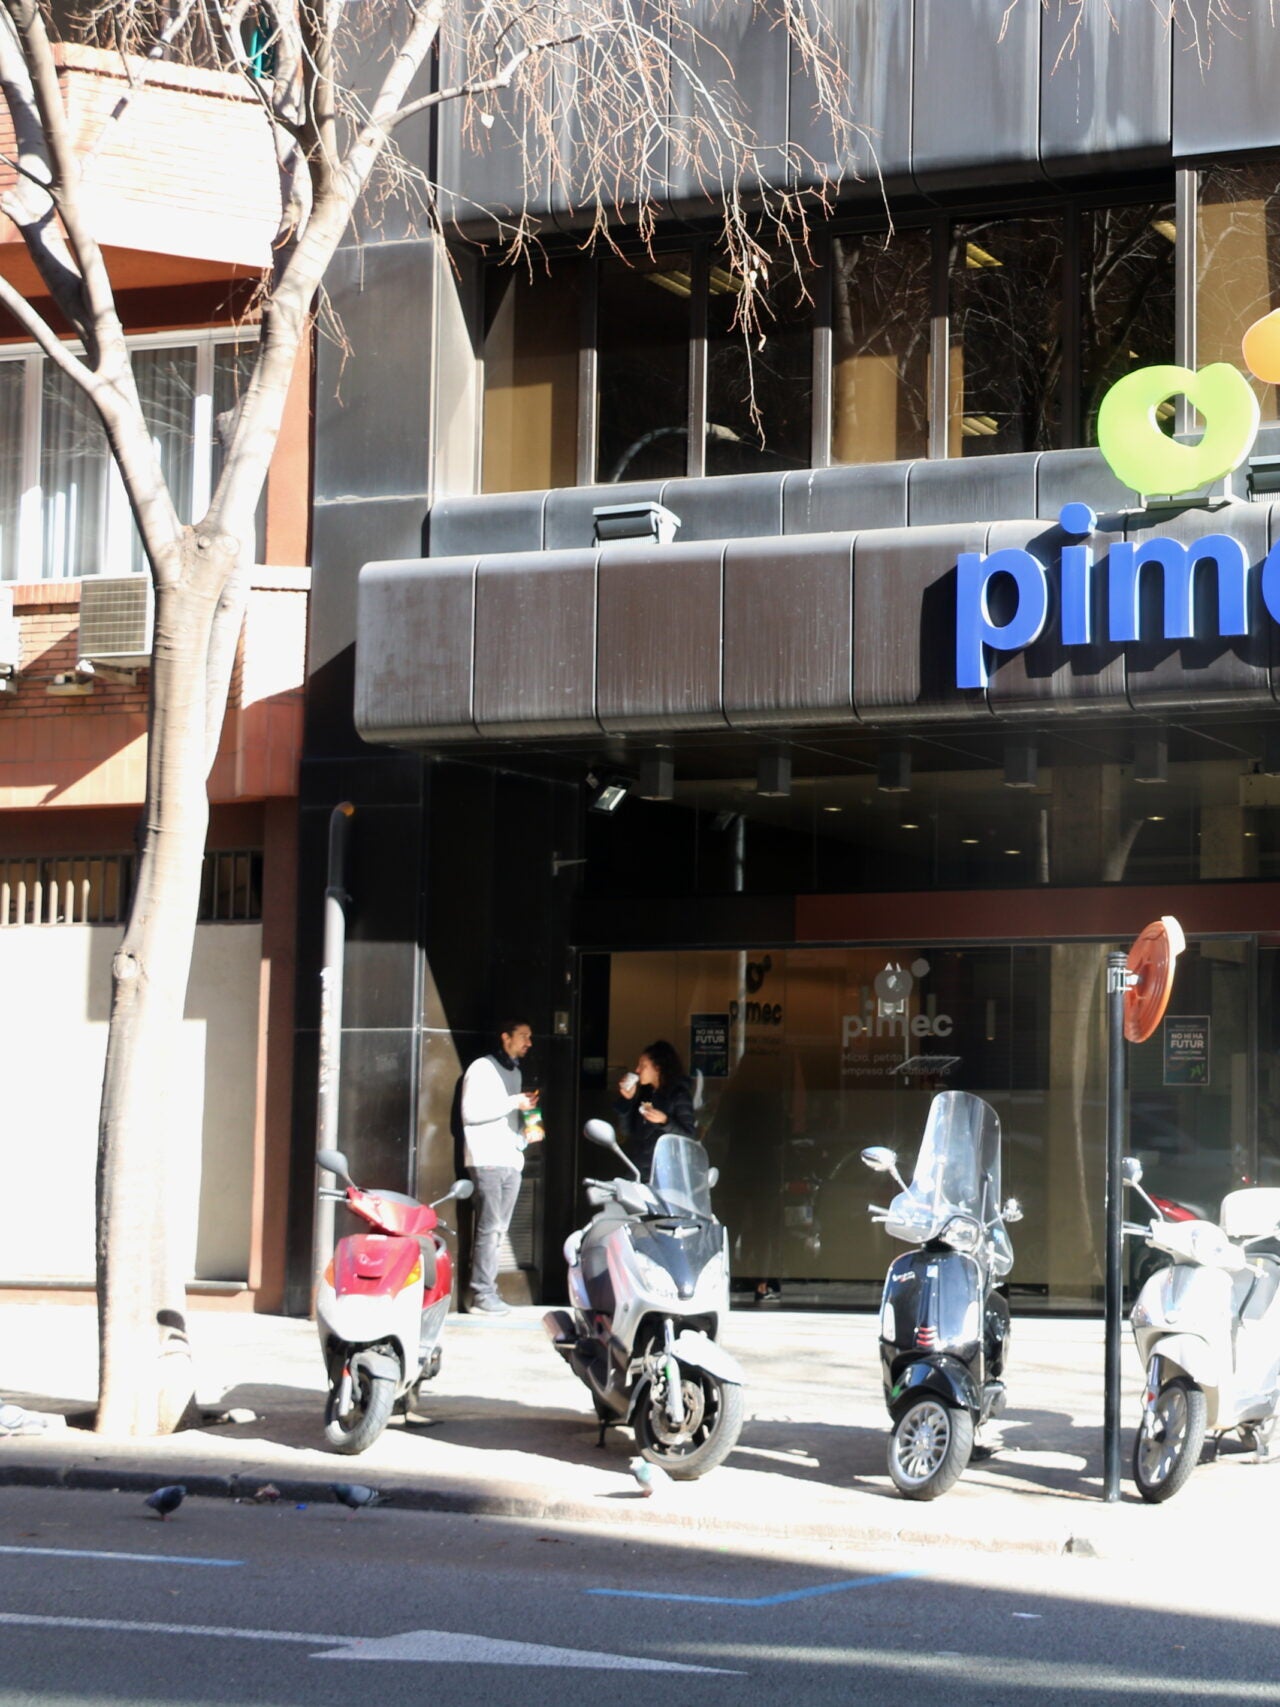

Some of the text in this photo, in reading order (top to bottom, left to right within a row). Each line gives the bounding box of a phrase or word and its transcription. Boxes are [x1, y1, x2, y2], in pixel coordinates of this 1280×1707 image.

[729, 1000, 782, 1026] pmec
[842, 1000, 953, 1047] pimec
[695, 1035, 726, 1044] FUTUR
[1170, 1040, 1204, 1048] FUTUR
